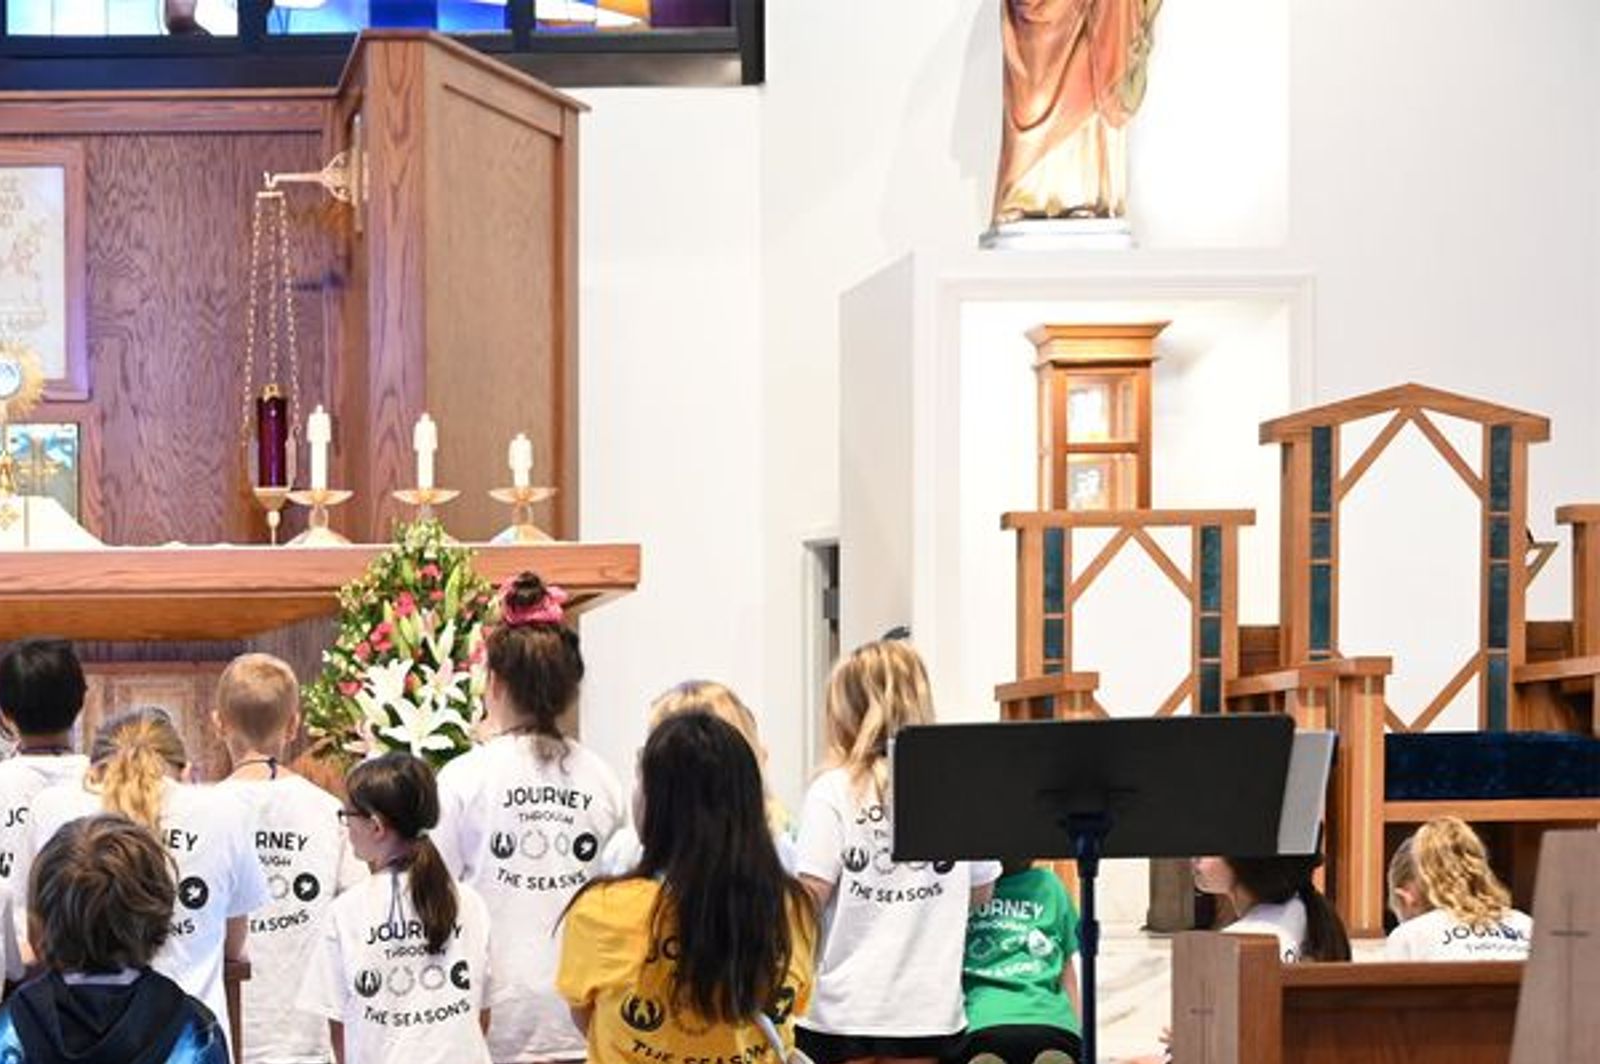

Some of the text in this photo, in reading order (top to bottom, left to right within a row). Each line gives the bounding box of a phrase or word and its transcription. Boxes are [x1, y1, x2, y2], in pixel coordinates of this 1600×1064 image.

[503, 786, 593, 811] JOURNEY
[518, 810, 574, 825] THROUGH
[255, 831, 308, 851] RNEY
[498, 868, 522, 888] THE
[849, 880, 943, 903] THE SEASONS
[969, 898, 1044, 920] URNEY
[250, 909, 310, 934] EASONS
[366, 919, 462, 945] JOURY
[364, 1000, 470, 1027] THE SEASONS
